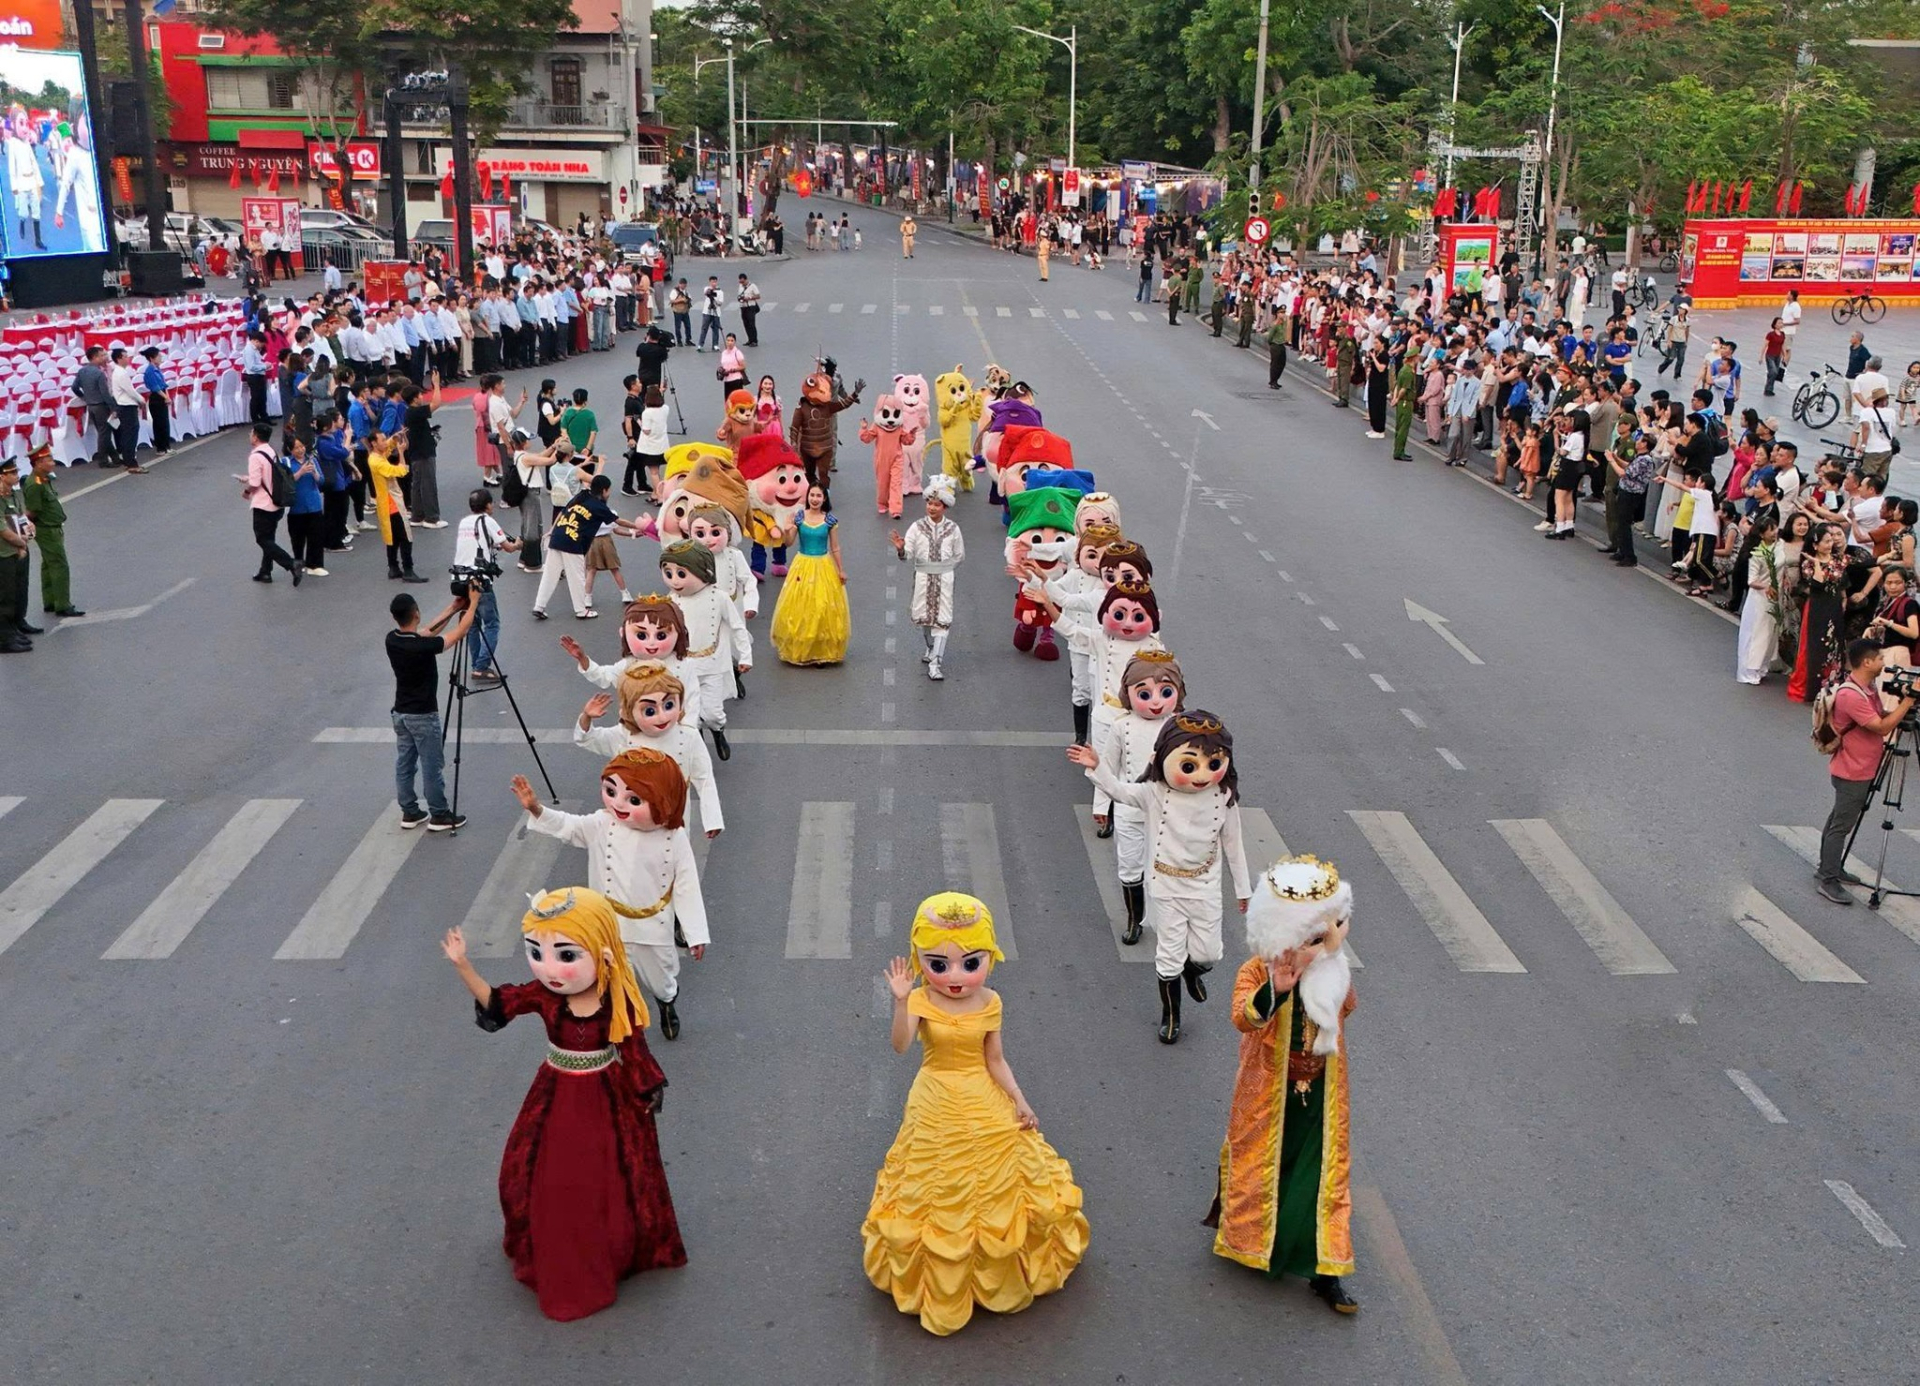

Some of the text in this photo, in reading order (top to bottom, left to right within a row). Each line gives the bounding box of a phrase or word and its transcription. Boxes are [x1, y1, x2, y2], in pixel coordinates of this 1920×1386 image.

[199, 147, 236, 155] COFFEE
[200, 157, 245, 169] TRUNG
[565, 526, 579, 541] vie
